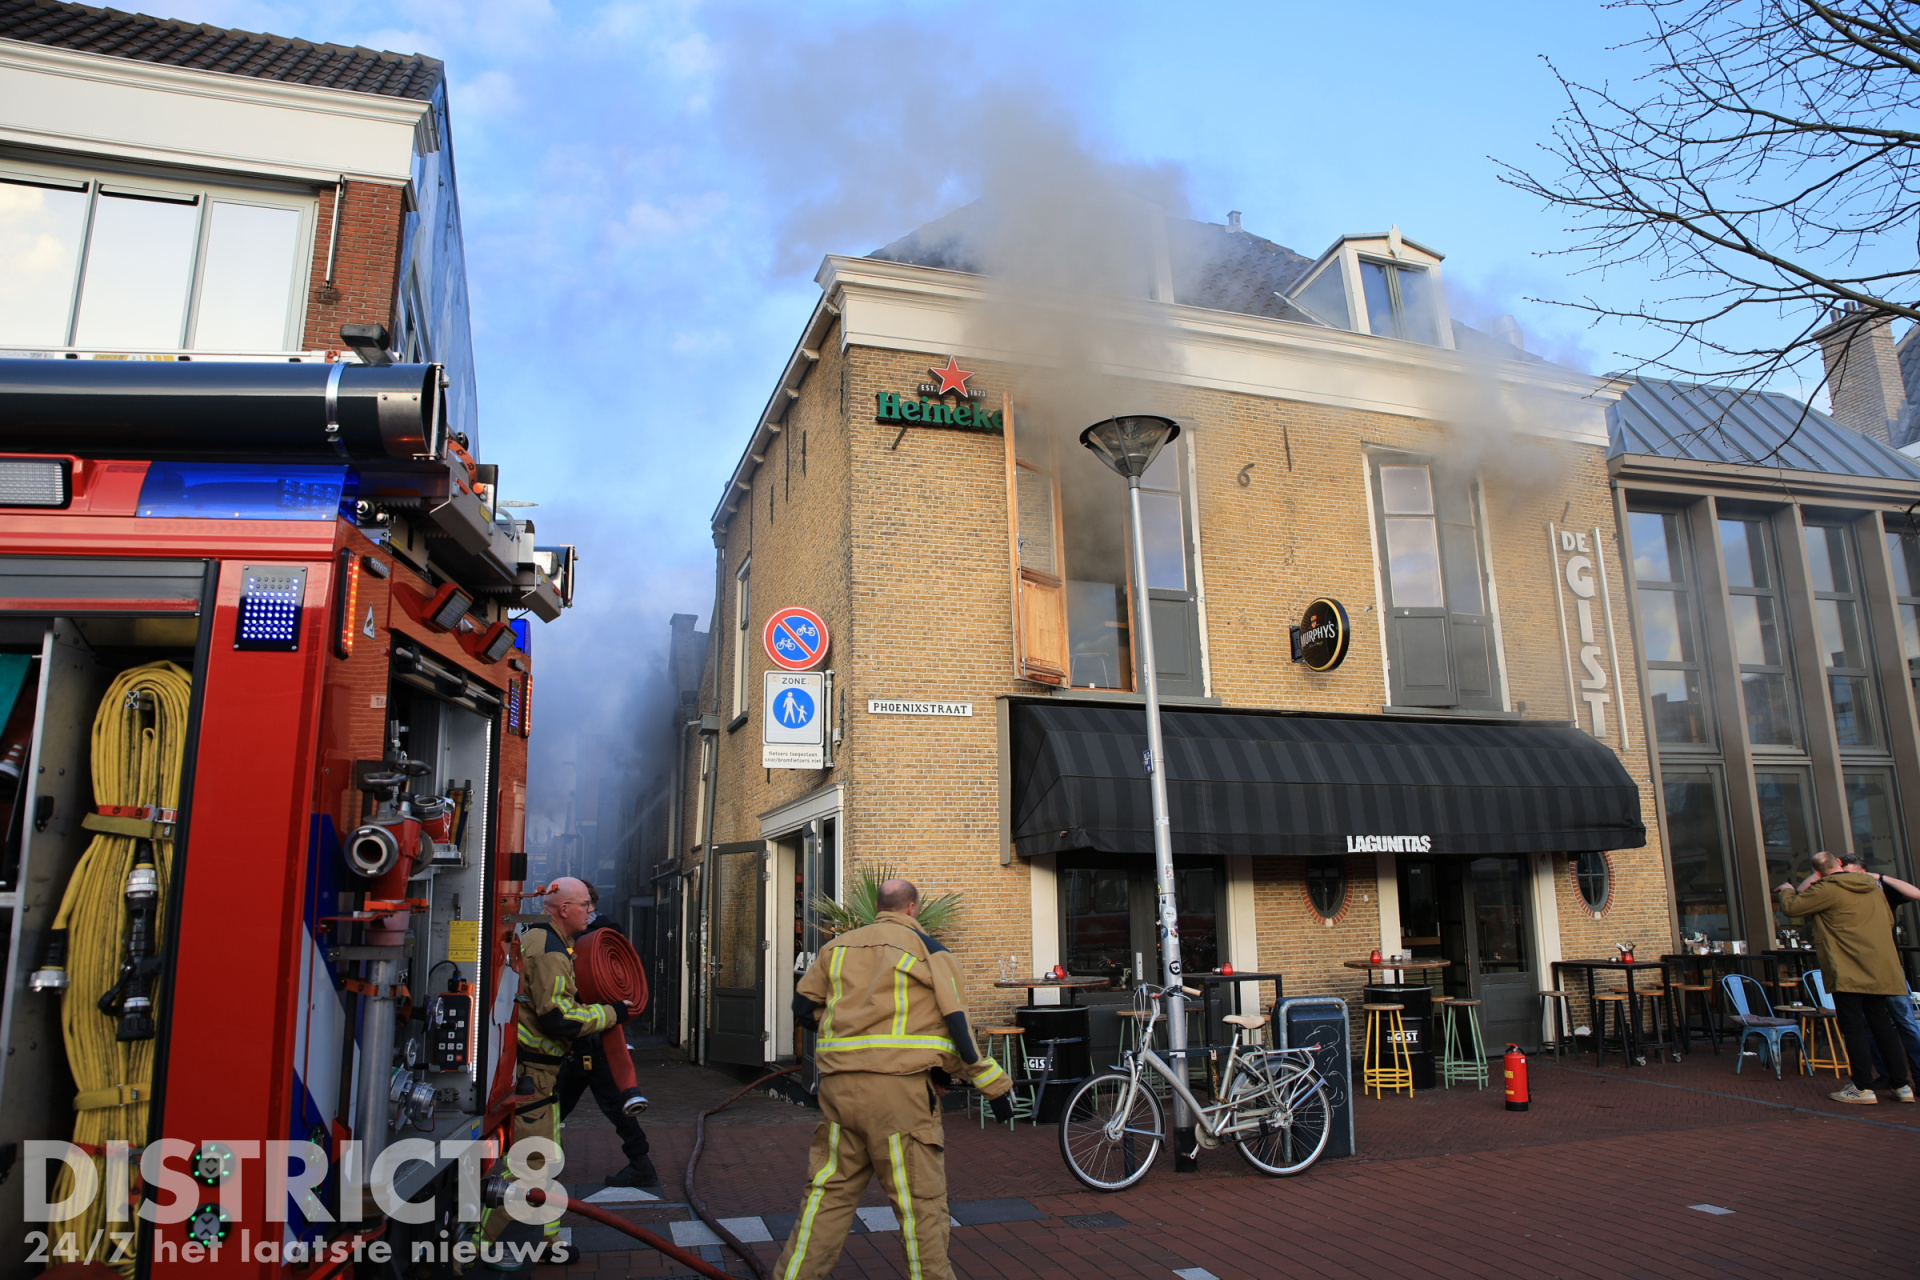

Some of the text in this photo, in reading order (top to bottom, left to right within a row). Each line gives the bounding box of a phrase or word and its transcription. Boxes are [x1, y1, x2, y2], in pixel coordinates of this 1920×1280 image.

[920, 384, 986, 398] EST. 1873
[876, 391, 1004, 430] Heineke
[1237, 462, 1256, 487] 6
[1561, 530, 1590, 553] DE
[1565, 555, 1611, 738] GIST
[781, 677, 807, 685] ZONE
[873, 702, 968, 714] PHOENIXSTRAAT
[1346, 834, 1432, 853] LAGUNITAS
